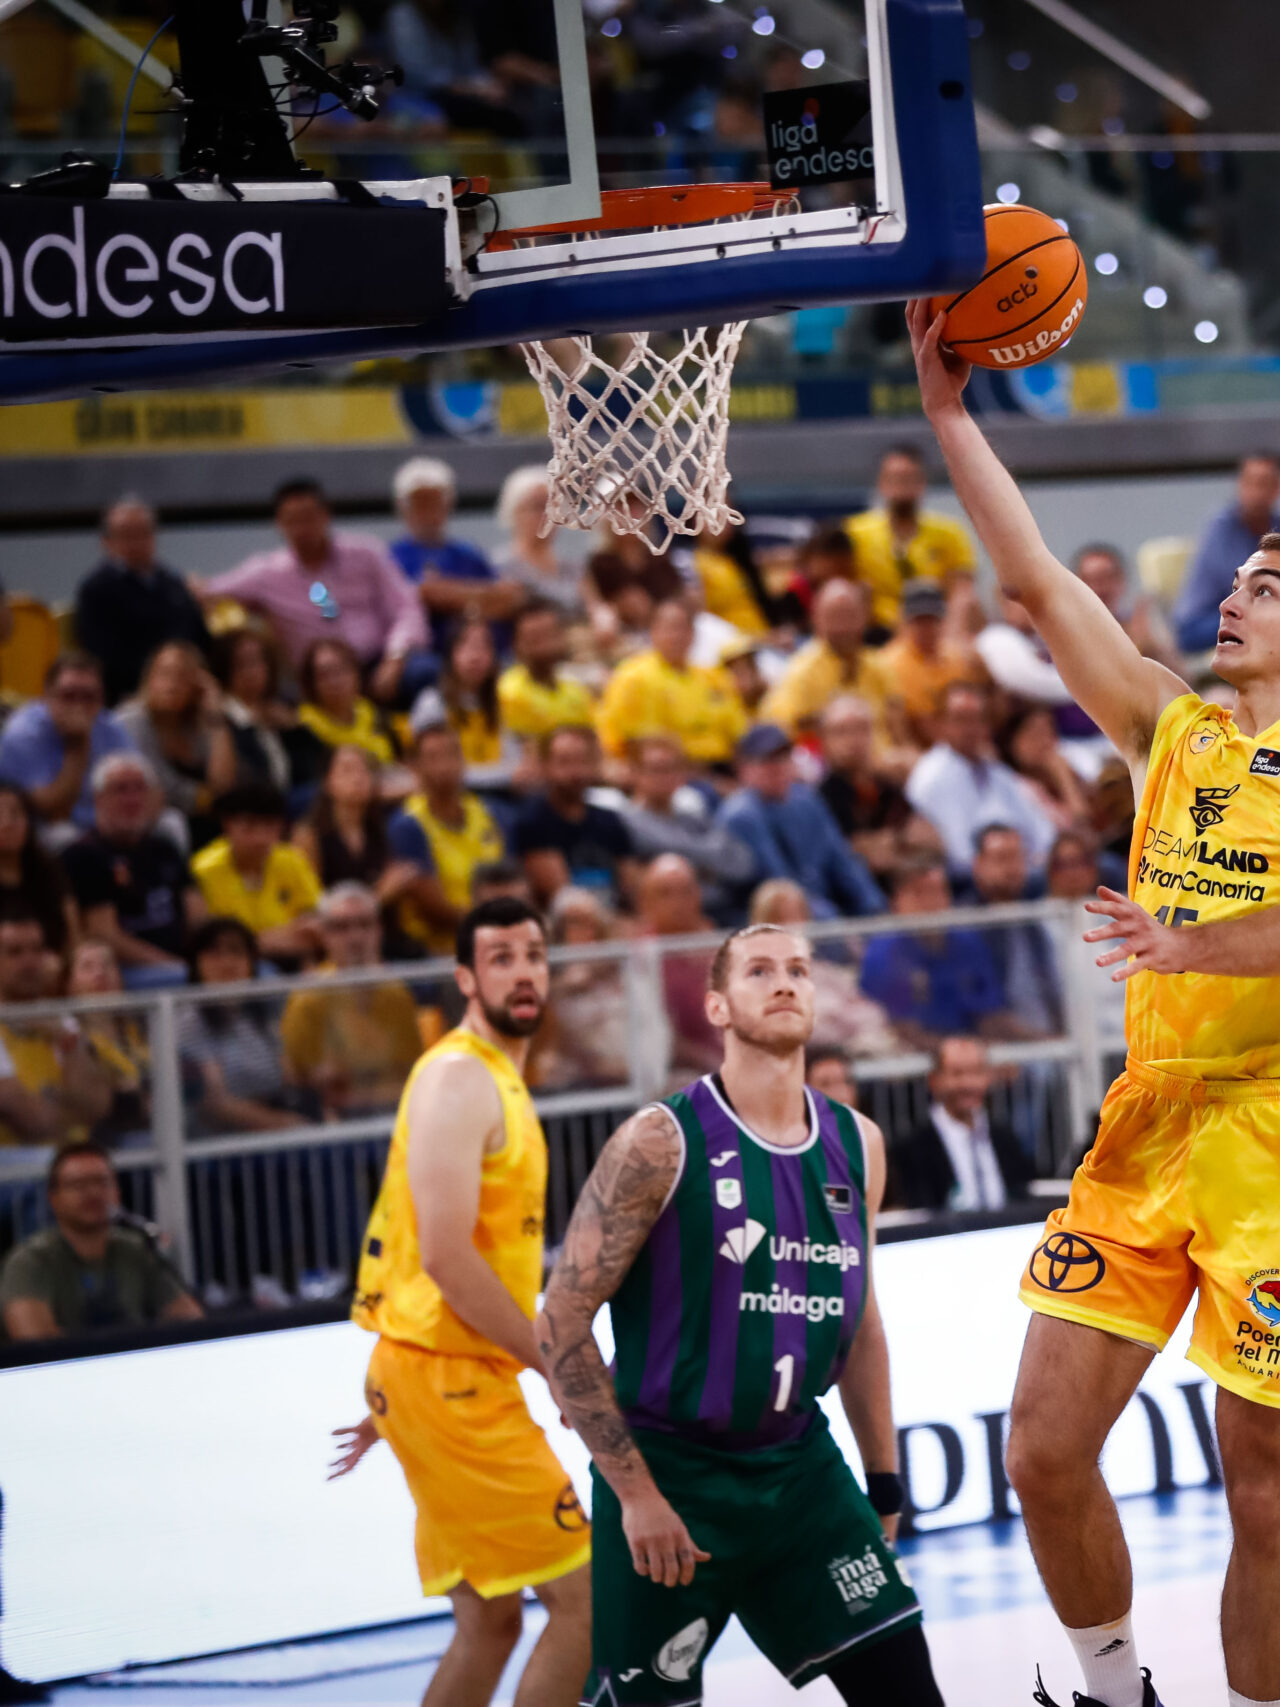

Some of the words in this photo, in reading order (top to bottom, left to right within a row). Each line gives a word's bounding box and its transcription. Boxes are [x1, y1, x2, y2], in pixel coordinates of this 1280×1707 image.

[771, 120, 818, 152] liga
[997, 282, 1038, 313] acb
[988, 298, 1084, 364] Wilson
[1252, 763, 1280, 773] endesa
[1255, 754, 1269, 764] liga
[1150, 863, 1265, 902] ranCanaria
[769, 1235, 860, 1272] Unicaja
[1245, 1268, 1280, 1286] DISCOVER
[739, 1283, 844, 1322] málaga
[1234, 1341, 1261, 1362] del
[774, 1354, 794, 1412] 1
[835, 1570, 889, 1602] laga
